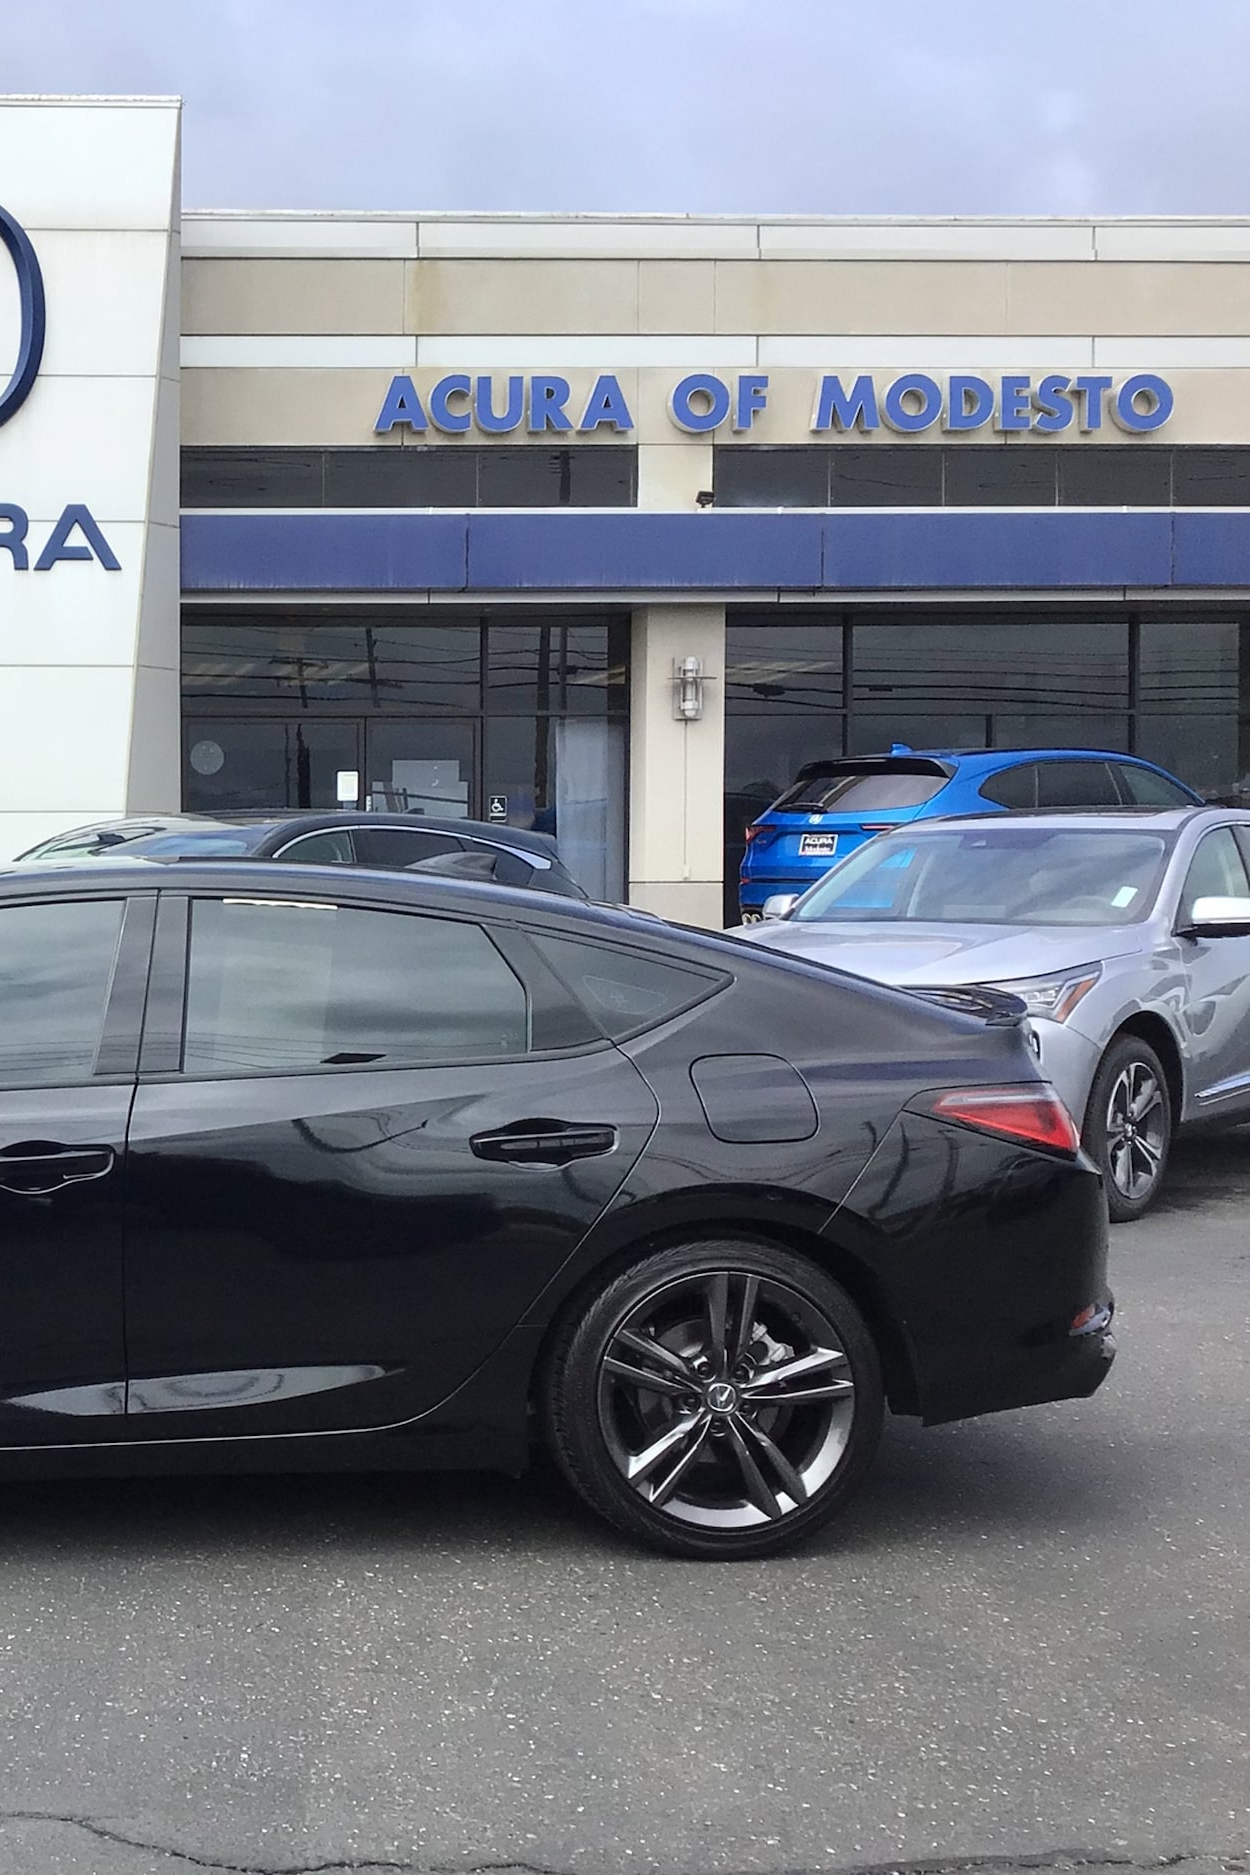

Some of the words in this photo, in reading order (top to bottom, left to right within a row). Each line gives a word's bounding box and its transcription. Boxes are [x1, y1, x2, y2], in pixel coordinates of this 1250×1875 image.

[374, 374, 635, 433] ACURA
[667, 374, 769, 433] OF
[811, 374, 1175, 433] MODESTO
[804, 837, 834, 845] ACURA
